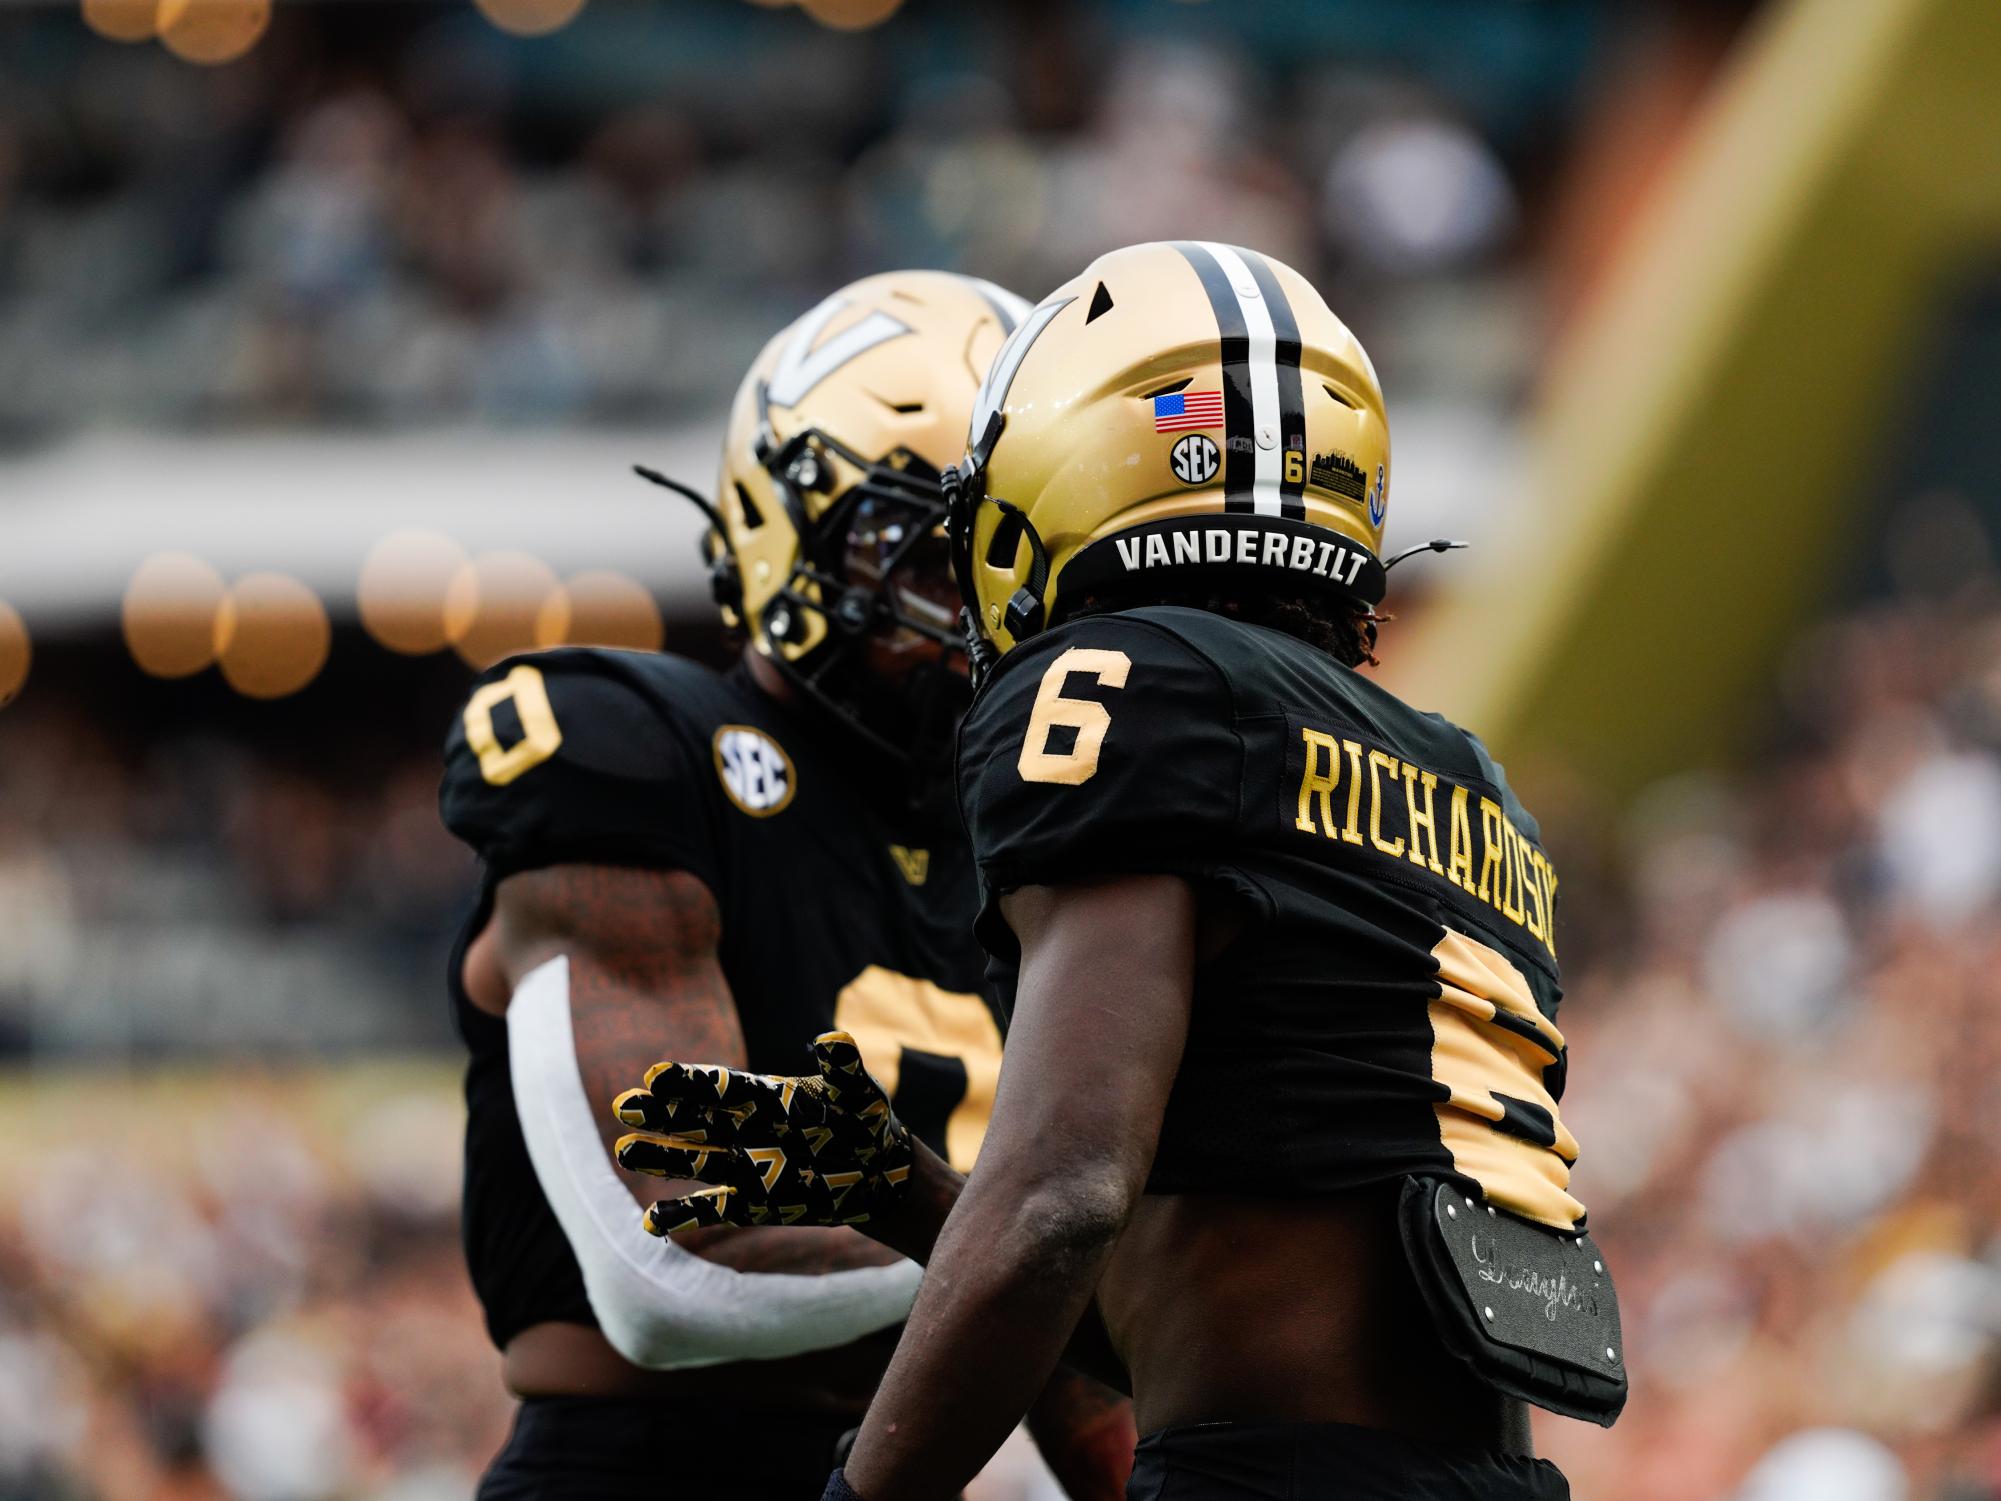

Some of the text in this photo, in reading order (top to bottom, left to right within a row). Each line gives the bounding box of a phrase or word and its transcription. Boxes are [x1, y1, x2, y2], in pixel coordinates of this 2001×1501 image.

[1172, 435, 1218, 483] SEC
[1285, 450, 1303, 483] 6
[1115, 529, 1368, 586] VANDERBILT
[463, 664, 563, 787] 0
[1017, 648, 1132, 786] 6
[718, 730, 788, 809] SEC
